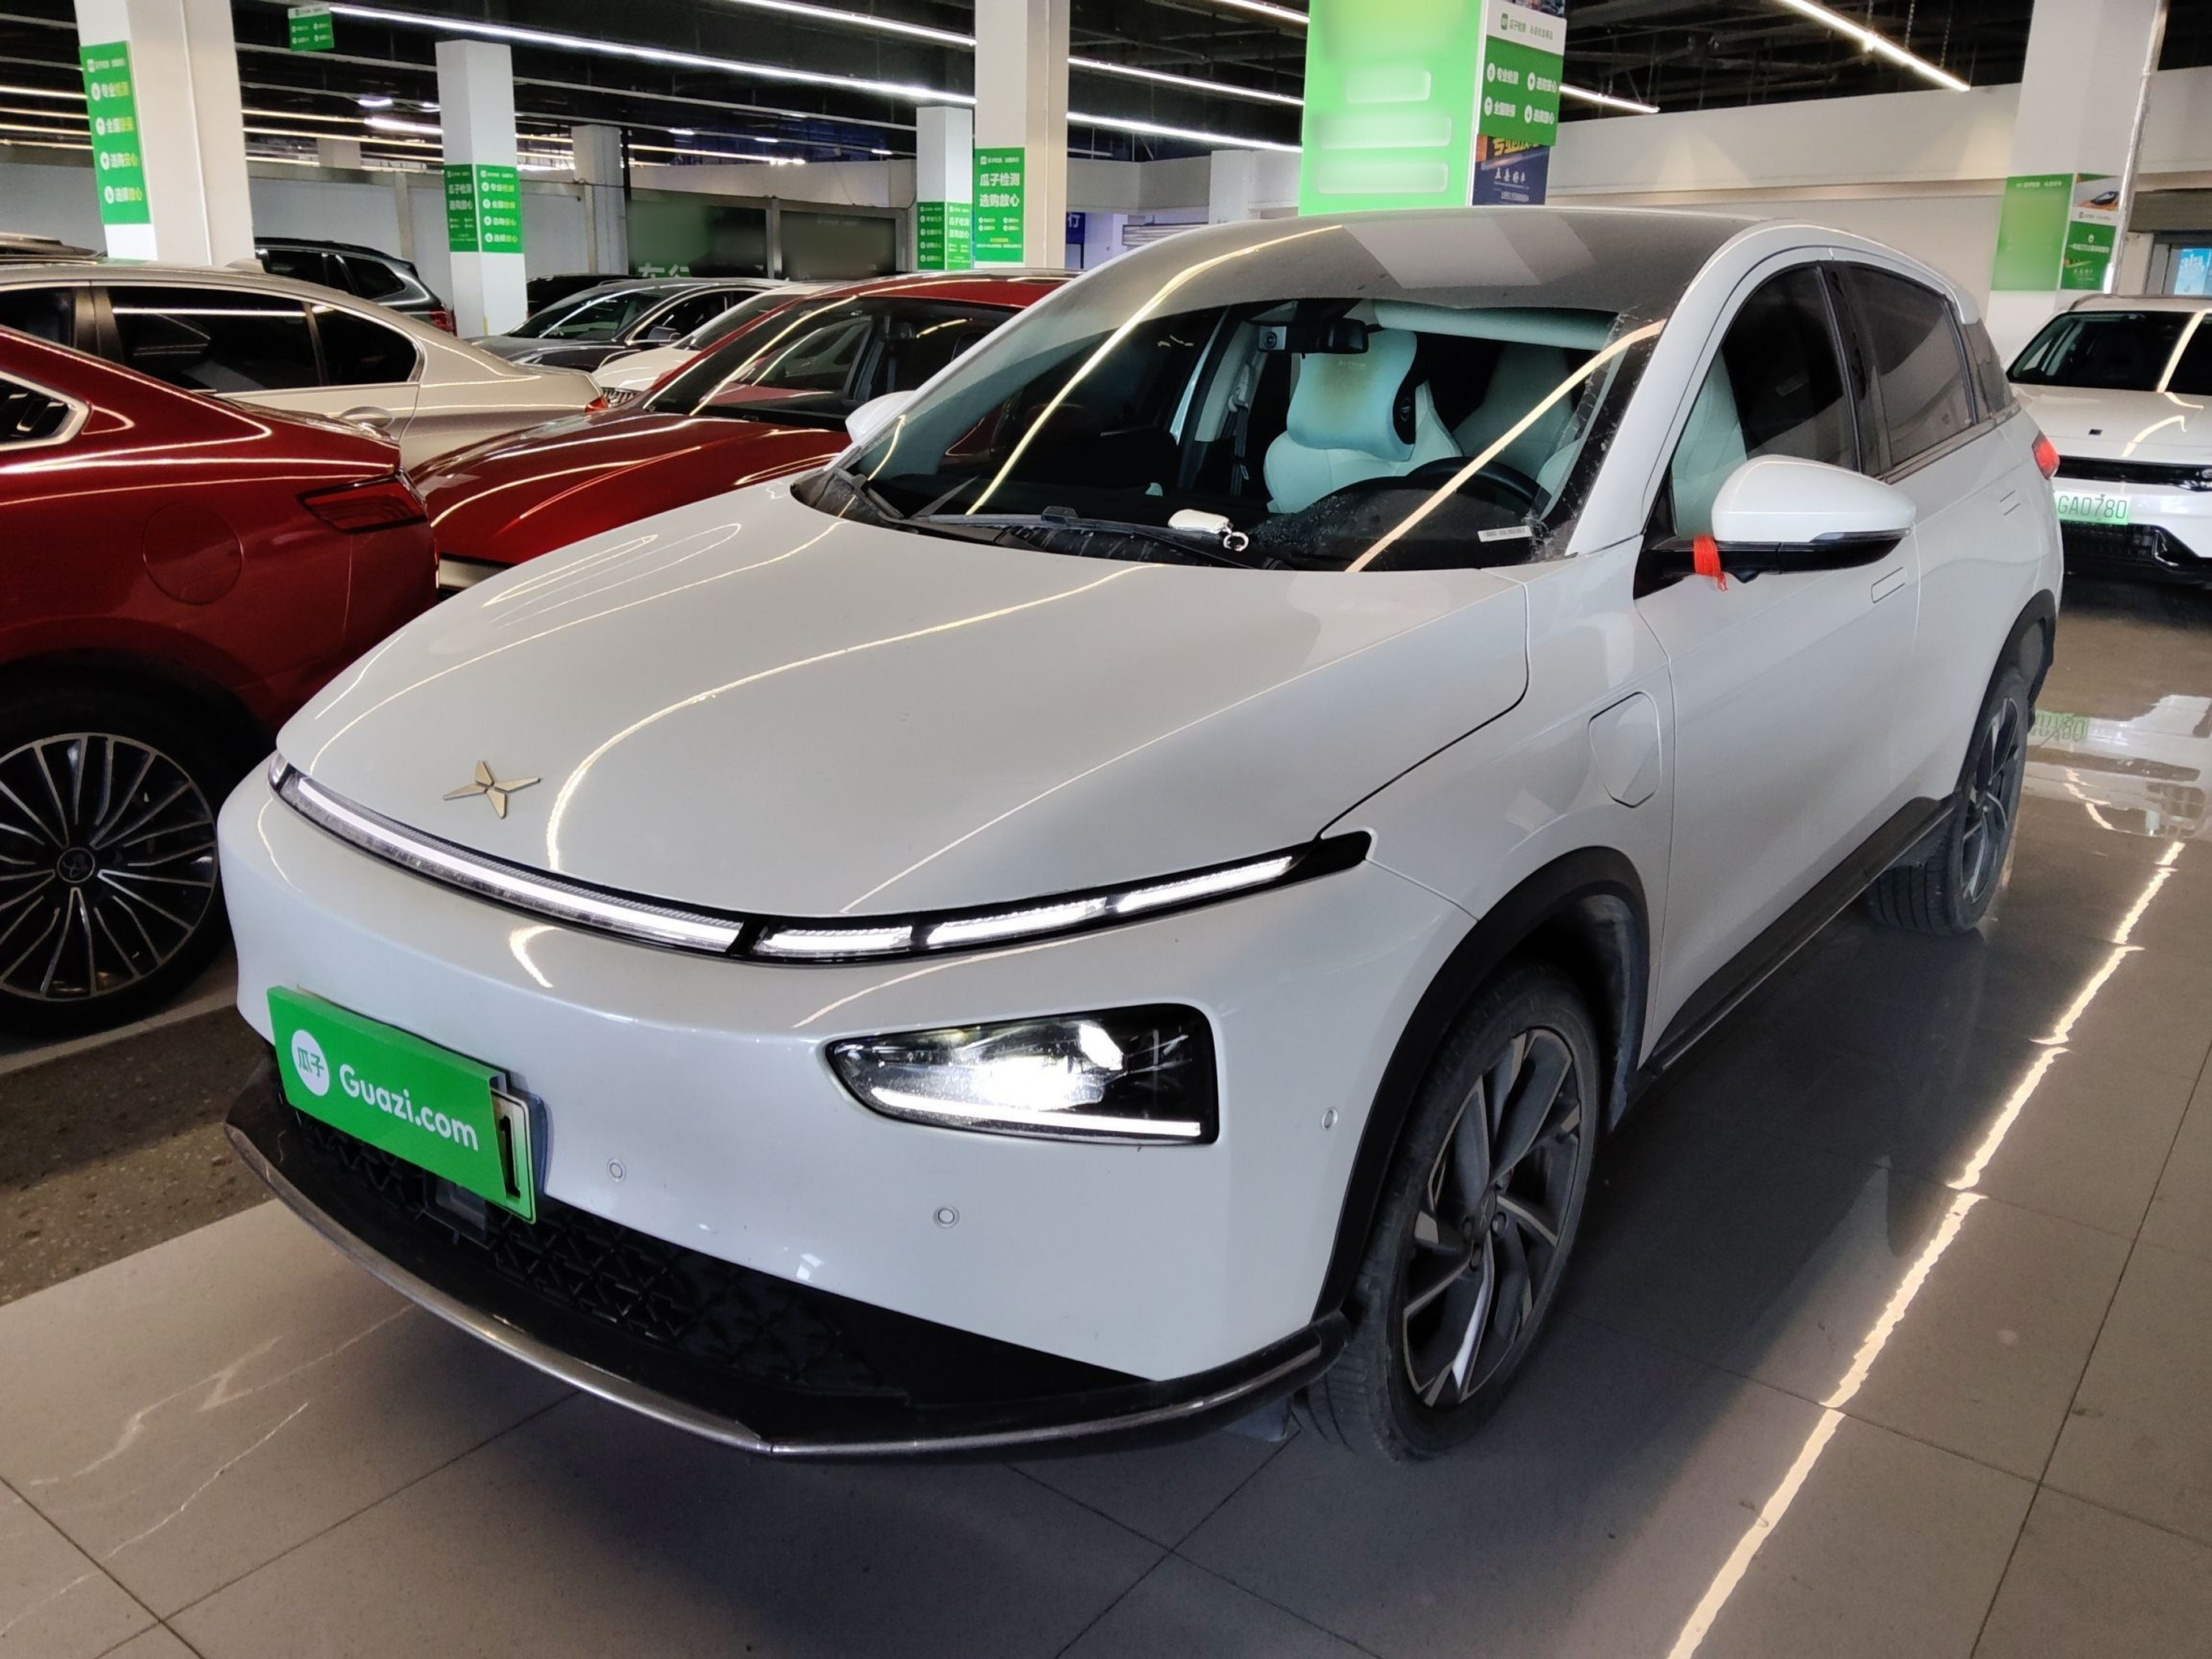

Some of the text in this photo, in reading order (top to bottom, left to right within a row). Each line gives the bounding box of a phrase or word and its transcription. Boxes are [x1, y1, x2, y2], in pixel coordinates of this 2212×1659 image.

[980, 172, 1020, 187] 瓜子检测
[980, 194, 1020, 208] 选购放心
[2058, 495, 2127, 519] GA0780
[297, 1046, 324, 1078] 瓜子
[339, 1063, 479, 1152] Guazi.com
